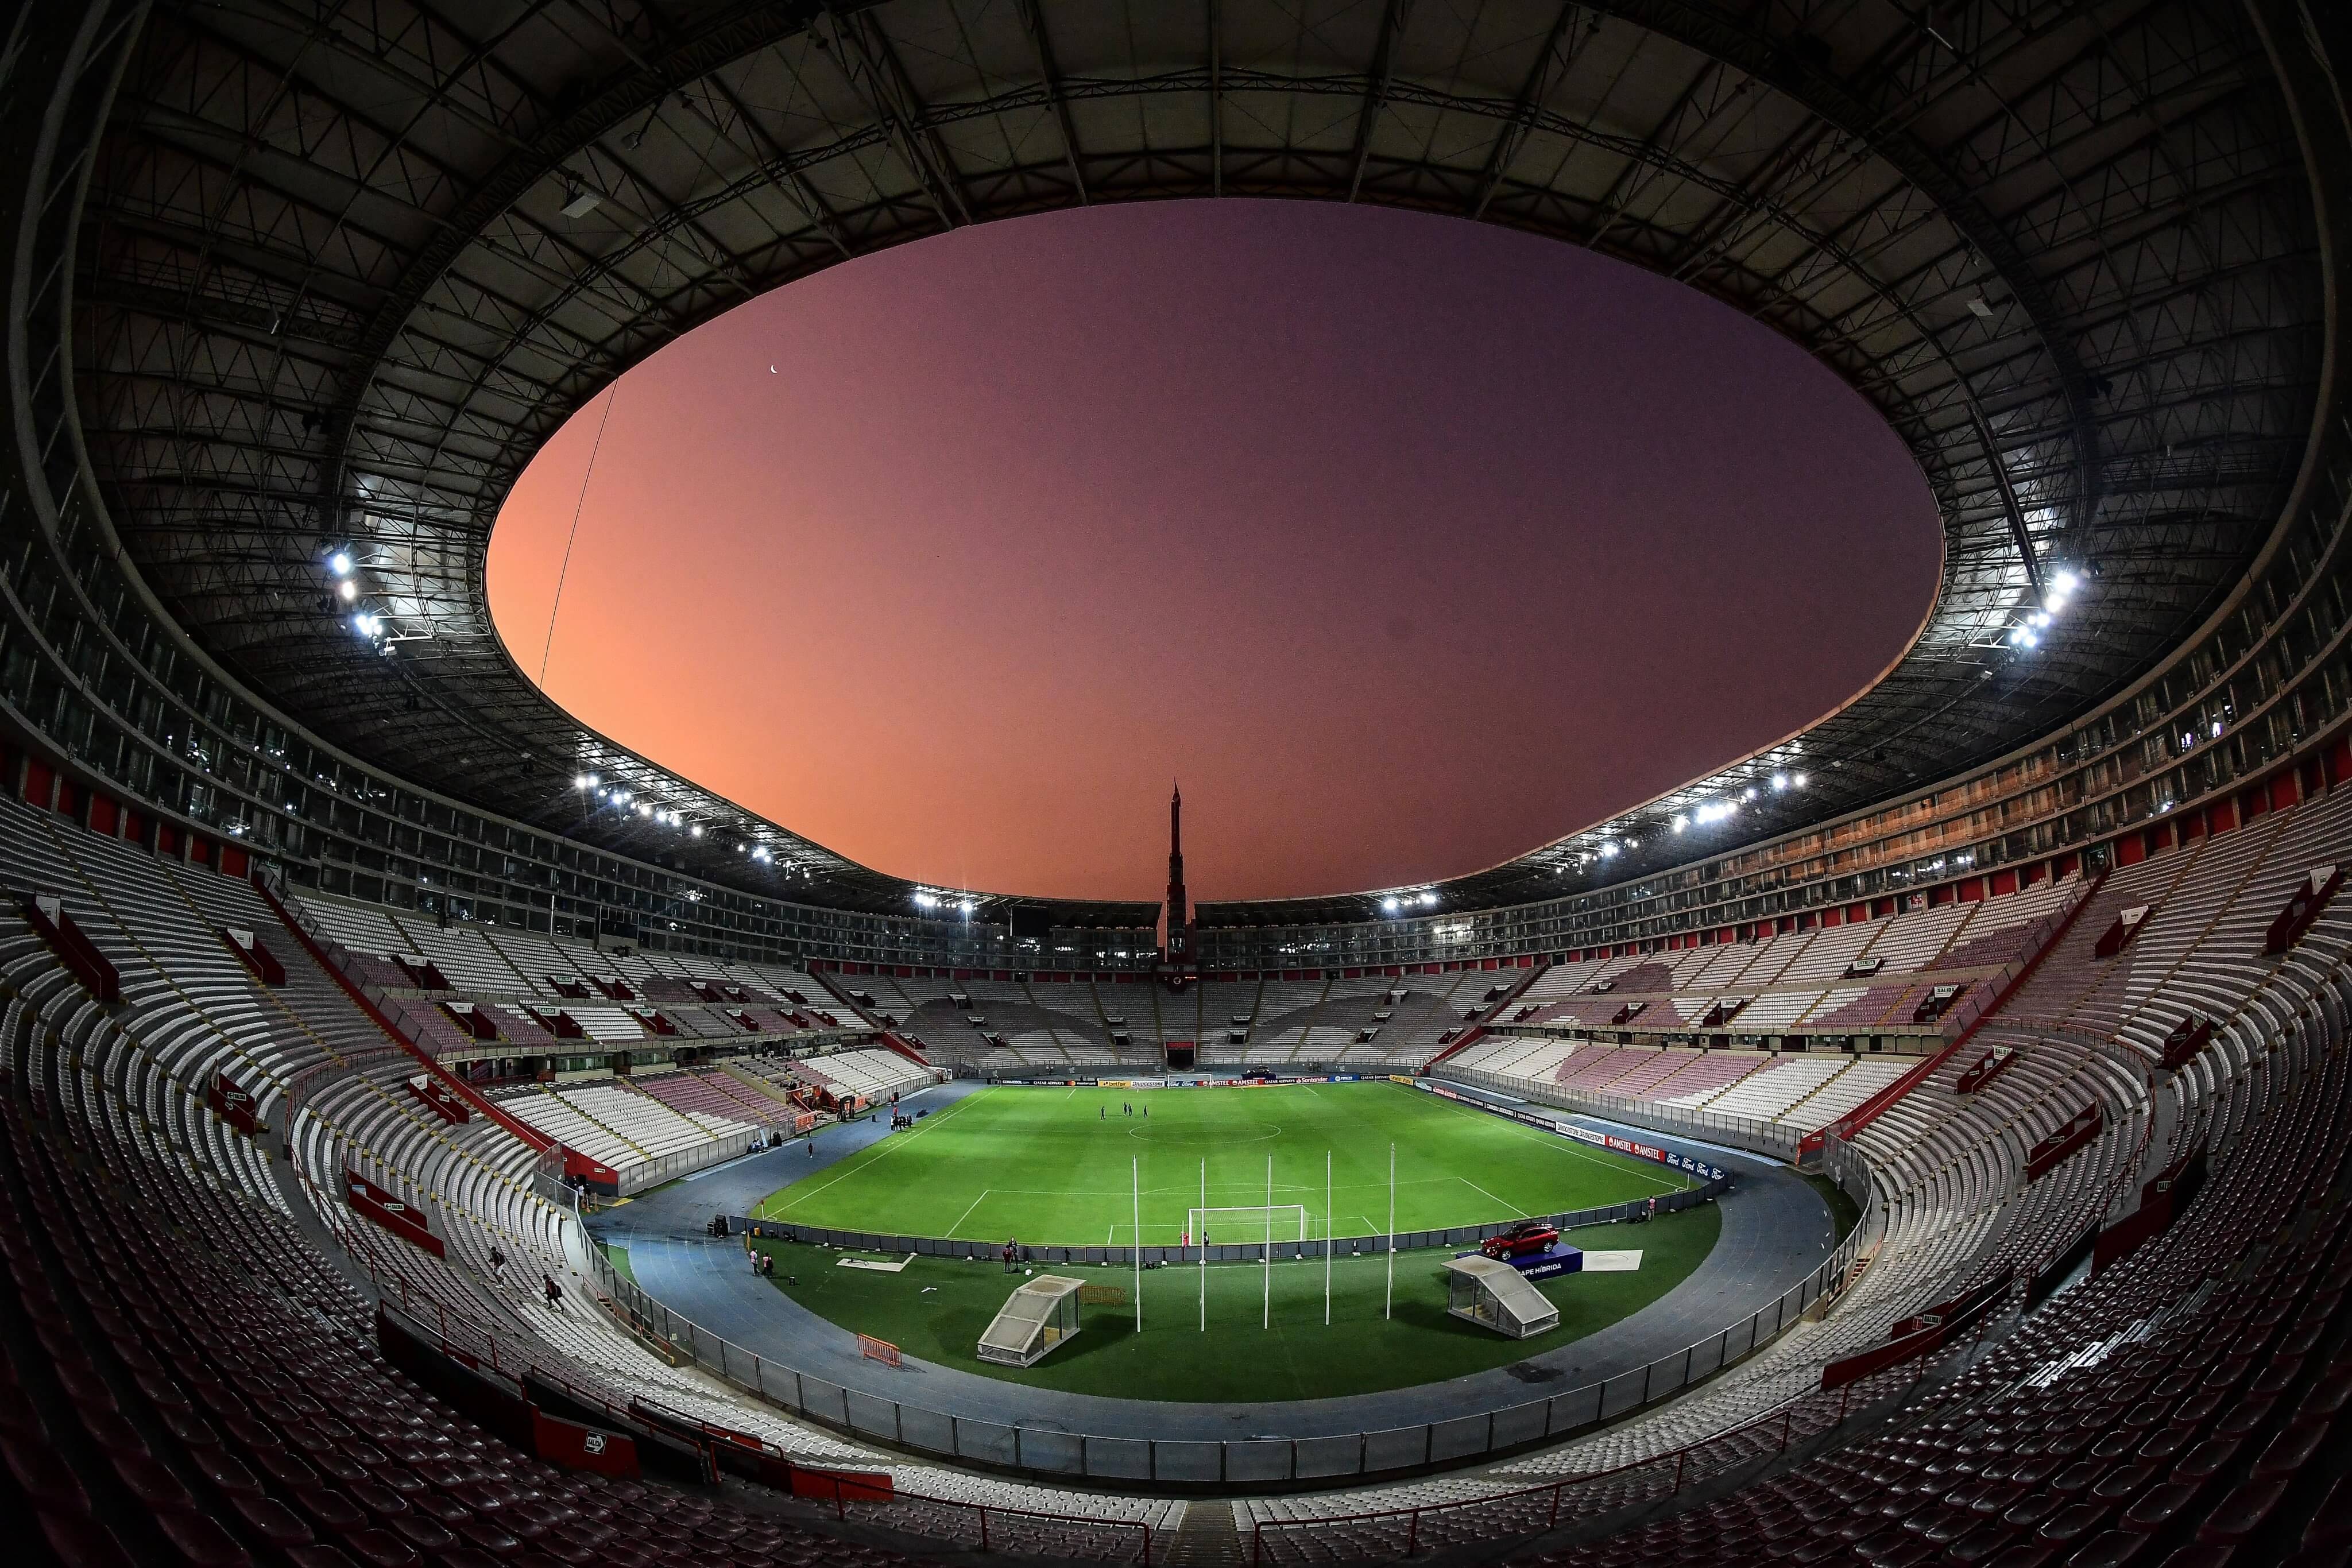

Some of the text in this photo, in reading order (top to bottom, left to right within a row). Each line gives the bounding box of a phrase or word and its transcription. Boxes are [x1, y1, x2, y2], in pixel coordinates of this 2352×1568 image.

[1558, 1124, 1579, 1136] BRIDGESTONE
[1579, 1129, 1603, 1143] BRIDGESTONE
[1613, 1140, 1631, 1152] AMSTEL
[1639, 1146, 1659, 1160] AMSTEL
[1667, 1153, 1680, 1166] Ford
[1682, 1157, 1695, 1171] Ford
[1696, 1162, 1709, 1176] Ford
[1535, 1263, 1561, 1273] HÍBRIDA
